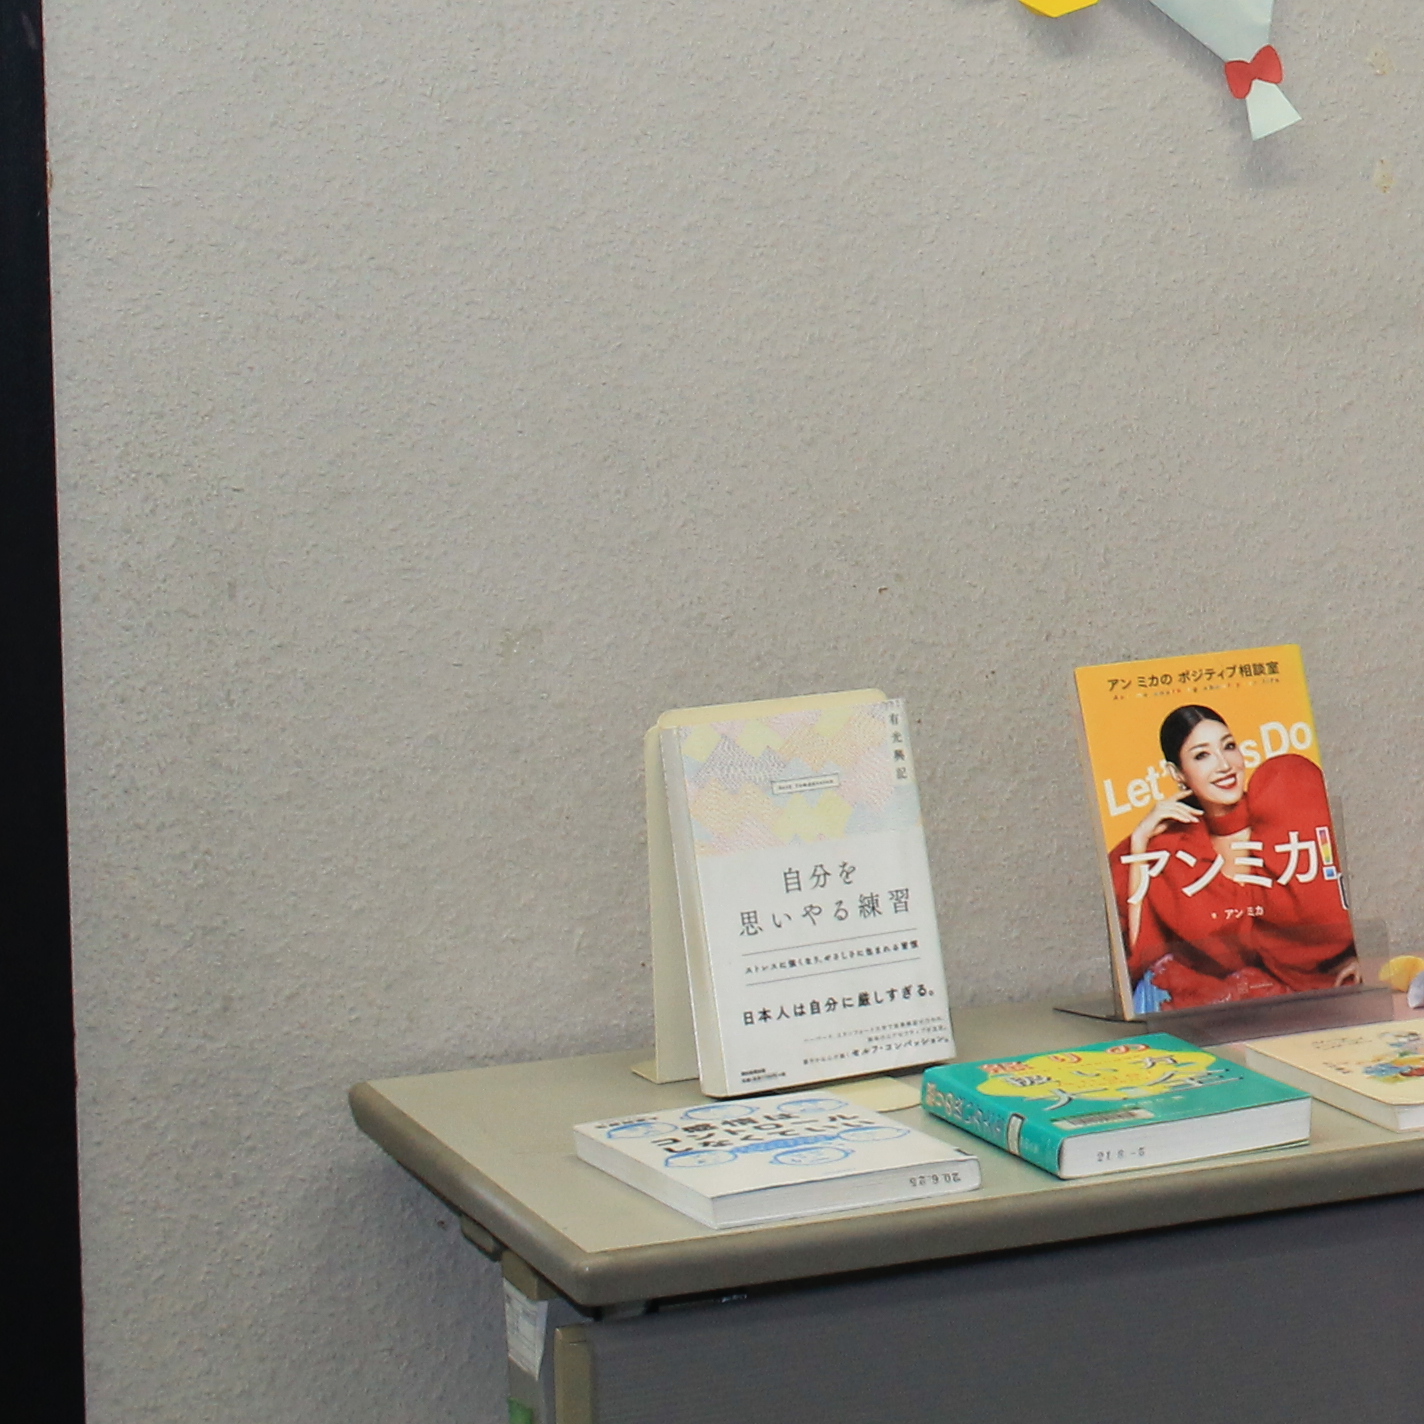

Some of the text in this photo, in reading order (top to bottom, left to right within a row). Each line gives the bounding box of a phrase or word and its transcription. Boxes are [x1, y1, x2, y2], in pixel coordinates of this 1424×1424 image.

[1177, 661, 1280, 684] ポジティブ相談室
[1260, 719, 1313, 760] Do
[782, 860, 857, 894] 自分を
[738, 888, 912, 937] 思いやる練習
[742, 983, 936, 1026] 日本人は自分に厳しすぎる。
[650, 1113, 860, 1149] コントロール
[662, 1119, 877, 1154] しなくていい
